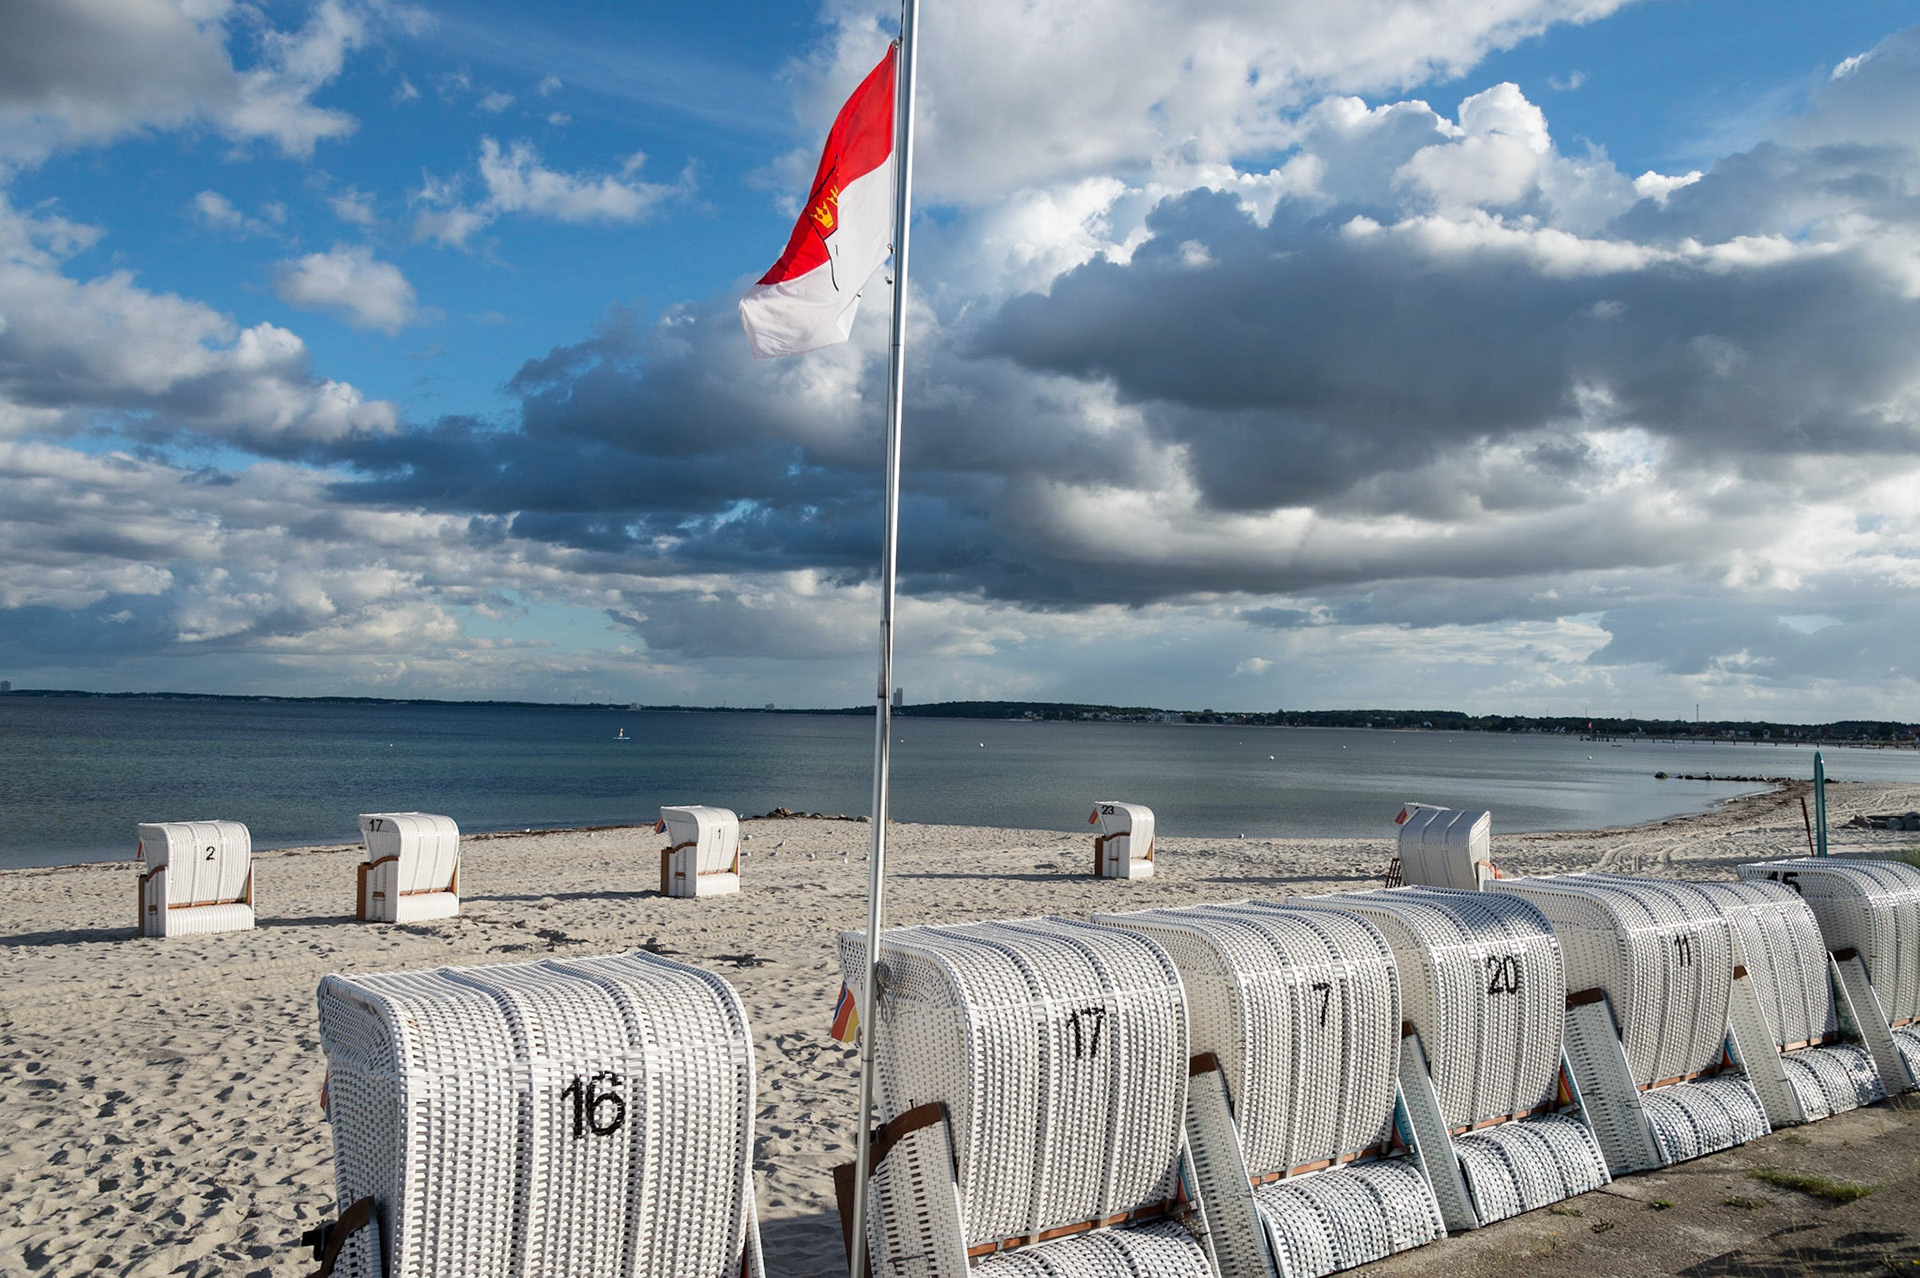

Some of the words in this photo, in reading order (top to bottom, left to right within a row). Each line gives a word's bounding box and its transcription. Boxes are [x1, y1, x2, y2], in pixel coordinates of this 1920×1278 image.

[369, 819, 383, 832] 17
[1102, 805, 1114, 815] 23
[717, 828, 721, 840] 1
[206, 846, 215, 860] 2
[1674, 933, 1691, 967] 11
[1487, 955, 1518, 994] 20
[1312, 982, 1333, 1028] 7
[1066, 1005, 1106, 1060] 17
[561, 1071, 626, 1140] 16
